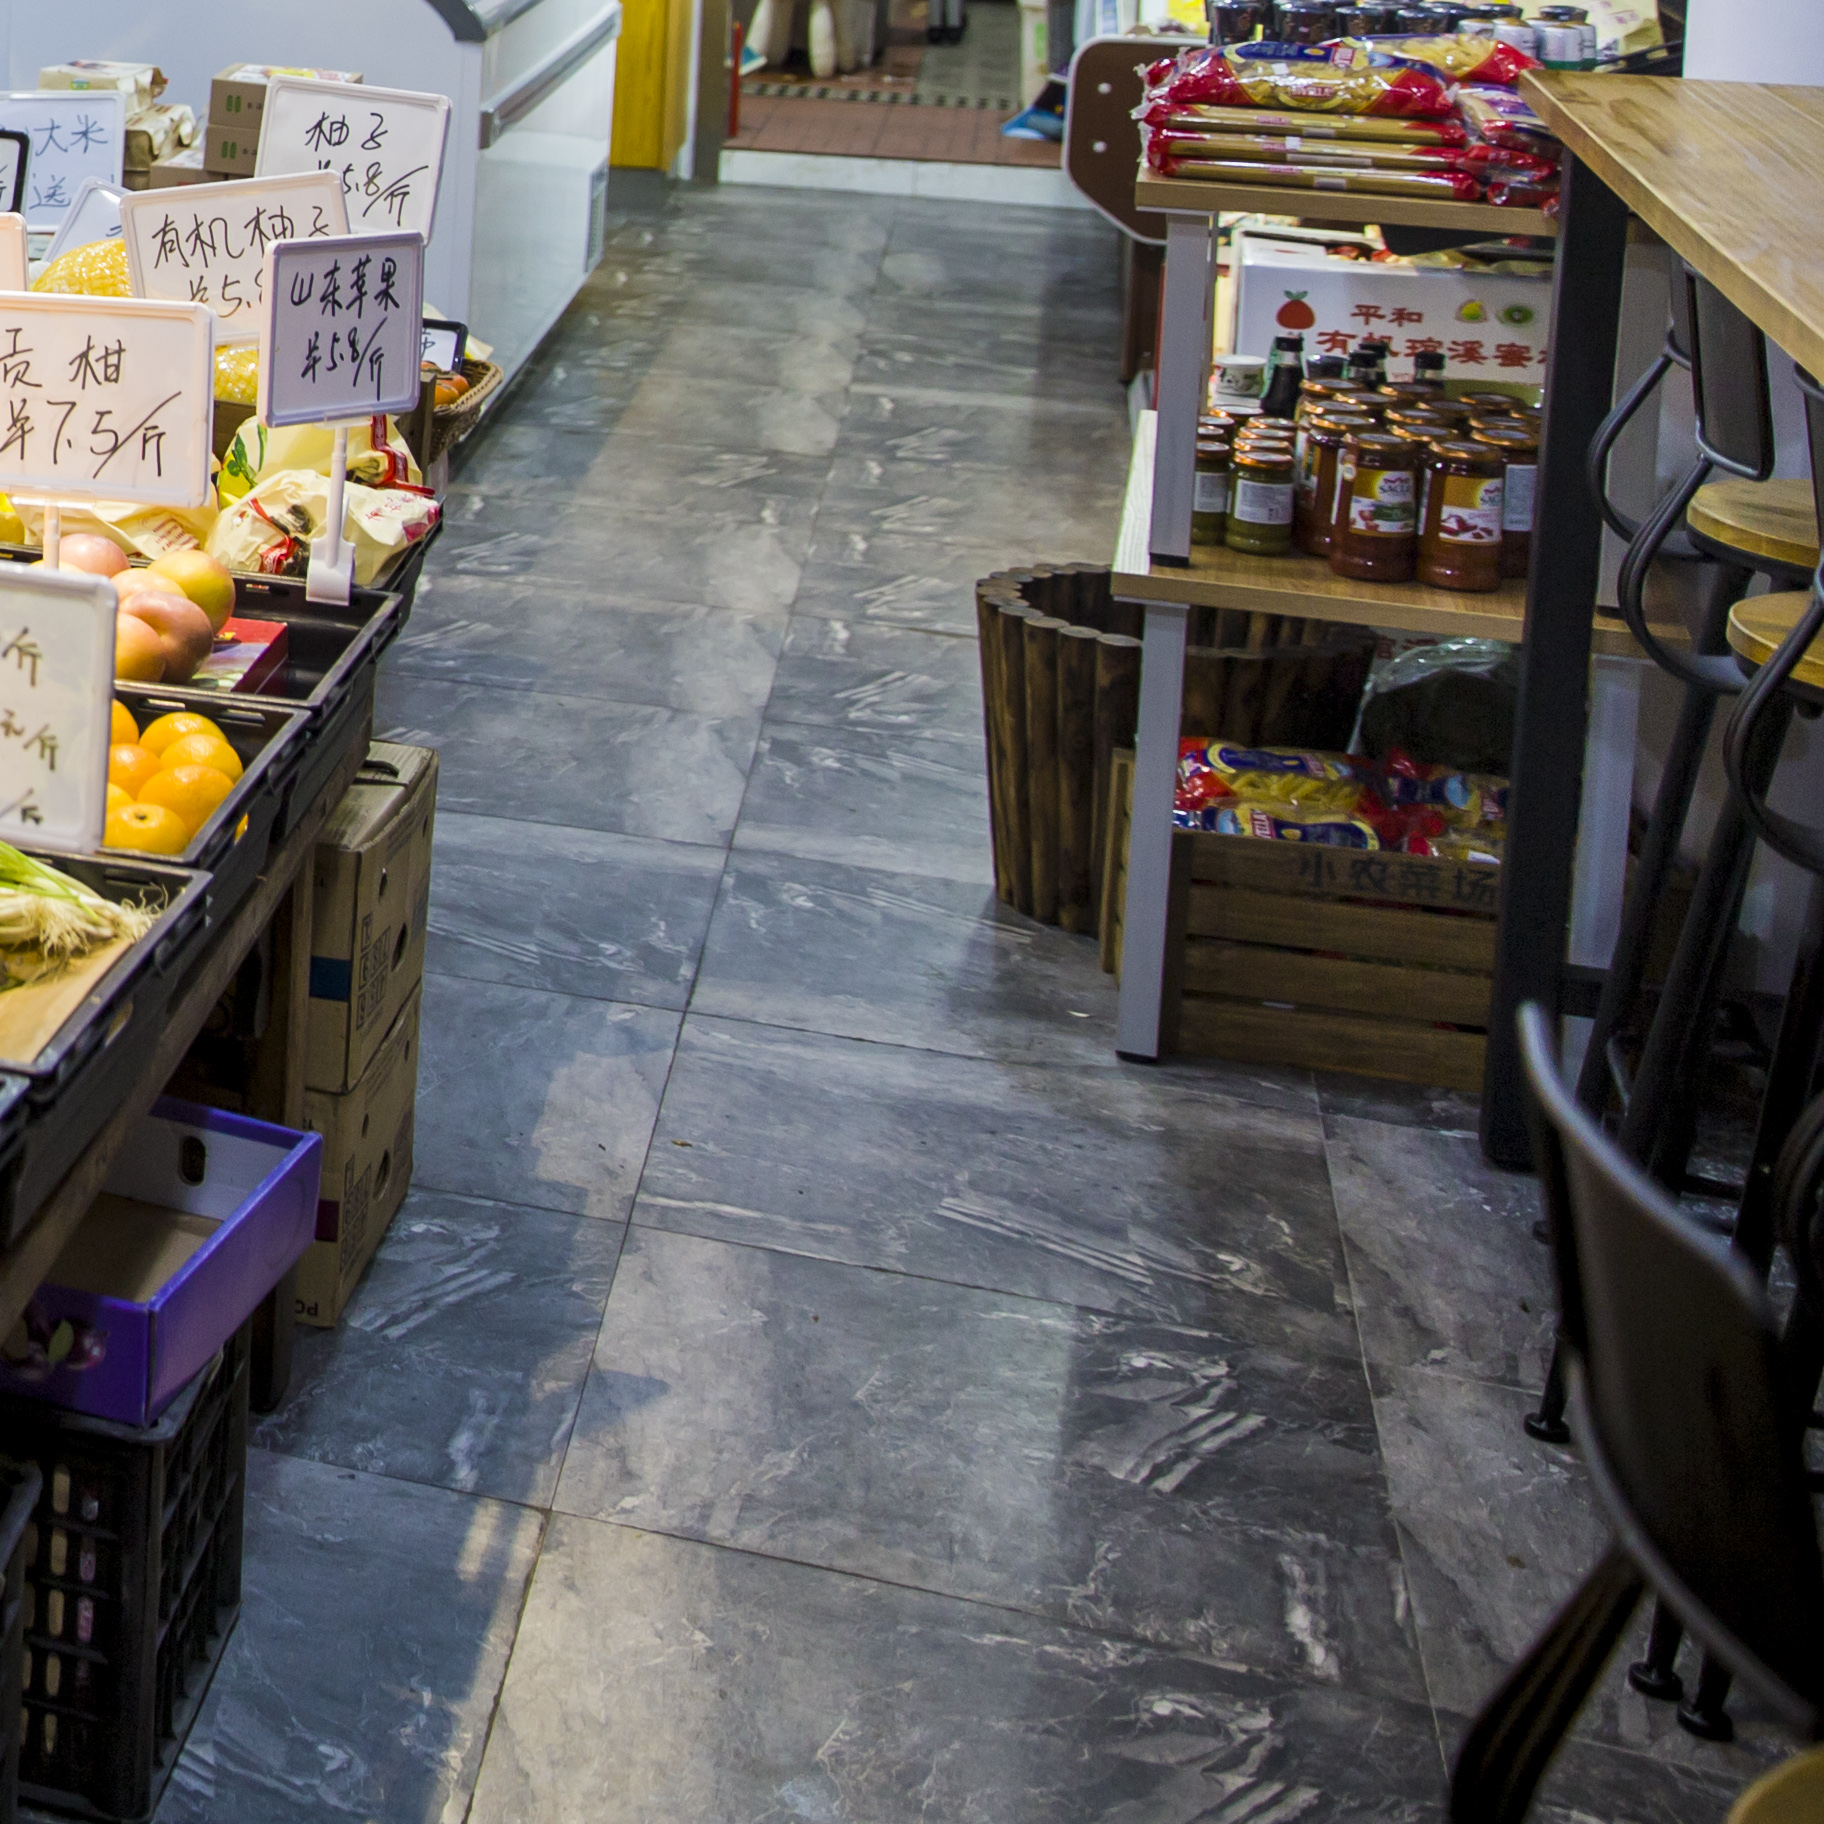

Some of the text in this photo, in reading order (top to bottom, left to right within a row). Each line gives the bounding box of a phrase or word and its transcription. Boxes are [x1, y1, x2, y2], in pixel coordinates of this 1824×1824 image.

[305, 110, 389, 153] 柚子
[289, 253, 402, 321] 山东苹果
[1350, 303, 1424, 327] 平和
[1299, 850, 1500, 912] 小农菜场
